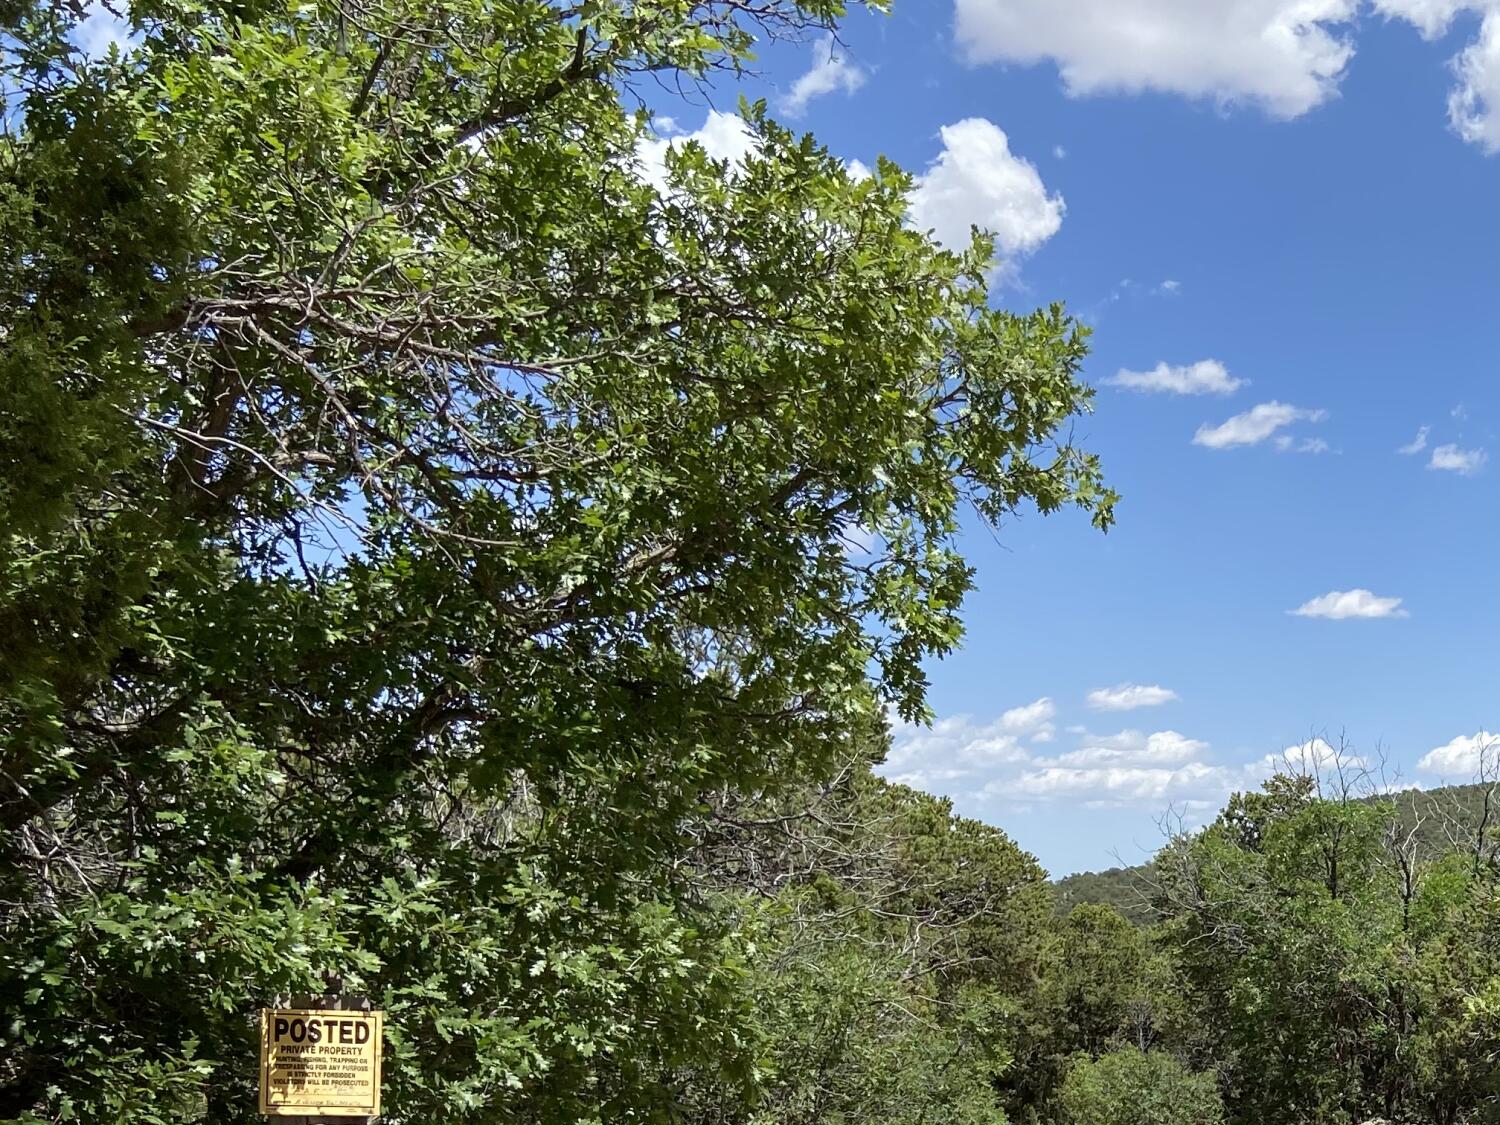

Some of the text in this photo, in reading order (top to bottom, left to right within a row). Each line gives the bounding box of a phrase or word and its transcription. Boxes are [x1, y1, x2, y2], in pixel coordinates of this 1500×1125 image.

[274, 1018, 370, 1044] POSTED
[280, 1045, 363, 1055] PRIVATE PROPERTY
[331, 1079, 369, 1087] PROSECUTED
